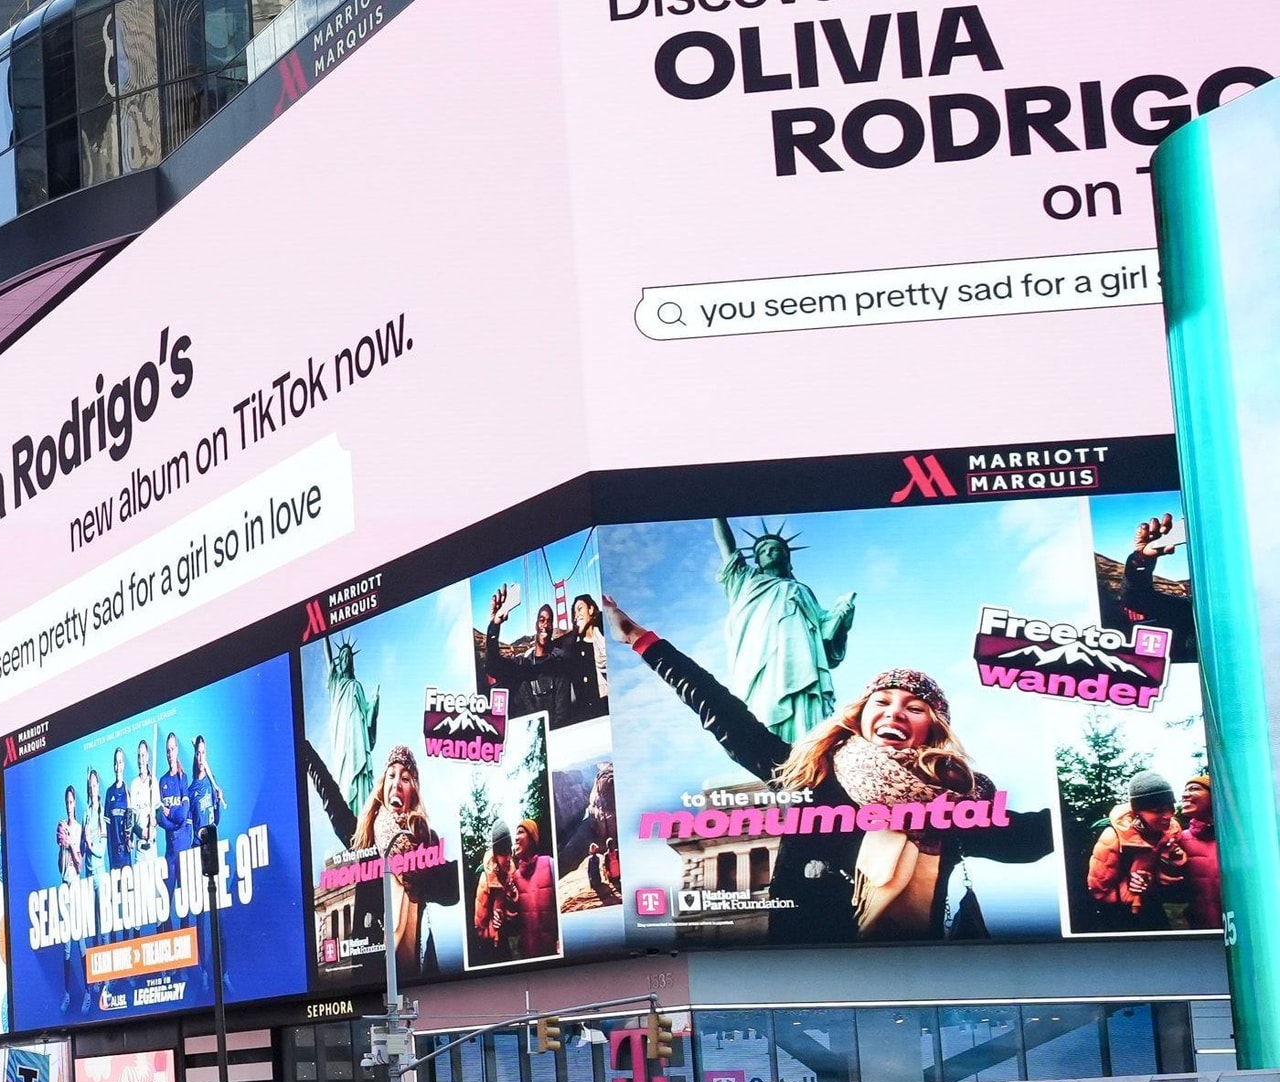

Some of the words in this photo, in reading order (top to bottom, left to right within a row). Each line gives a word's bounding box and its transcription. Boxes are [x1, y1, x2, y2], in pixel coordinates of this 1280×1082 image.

[654, 5, 1004, 100] OLIVIA
[1042, 178, 1123, 222] on
[699, 296, 756, 328] you
[764, 290, 847, 318] seem
[854, 277, 950, 317] pretty
[957, 274, 1014, 304] sad
[1020, 269, 1066, 300] for
[1073, 274, 1093, 295] a
[1099, 264, 1149, 304] girl
[11, 326, 195, 509] Rodrigo's
[69, 504, 114, 553] new
[120, 448, 190, 528] album
[196, 431, 229, 480] on
[233, 367, 329, 451] TikTok
[968, 446, 1110, 470] MARRIOTT
[970, 468, 1095, 492] MARQUIS
[39, 606, 88, 664] pretty
[93, 592, 127, 640] sad
[129, 573, 157, 613] for
[176, 543, 210, 601] girl
[213, 532, 241, 565] so
[245, 512, 267, 553] in
[270, 483, 324, 536] love
[328, 573, 383, 607] MARRIOTT
[330, 594, 378, 624] MARQUIS
[977, 659, 1159, 710] wander
[424, 735, 504, 763] wander
[639, 791, 1010, 840] monumental
[681, 791, 707, 808] to
[710, 790, 751, 808] the
[754, 789, 814, 807] most
[28, 876, 96, 950] SEASON
[99, 857, 170, 935] BEGINS
[702, 889, 751, 900] National
[703, 901, 730, 911] Park
[307, 1000, 353, 1018] SEPHORA
